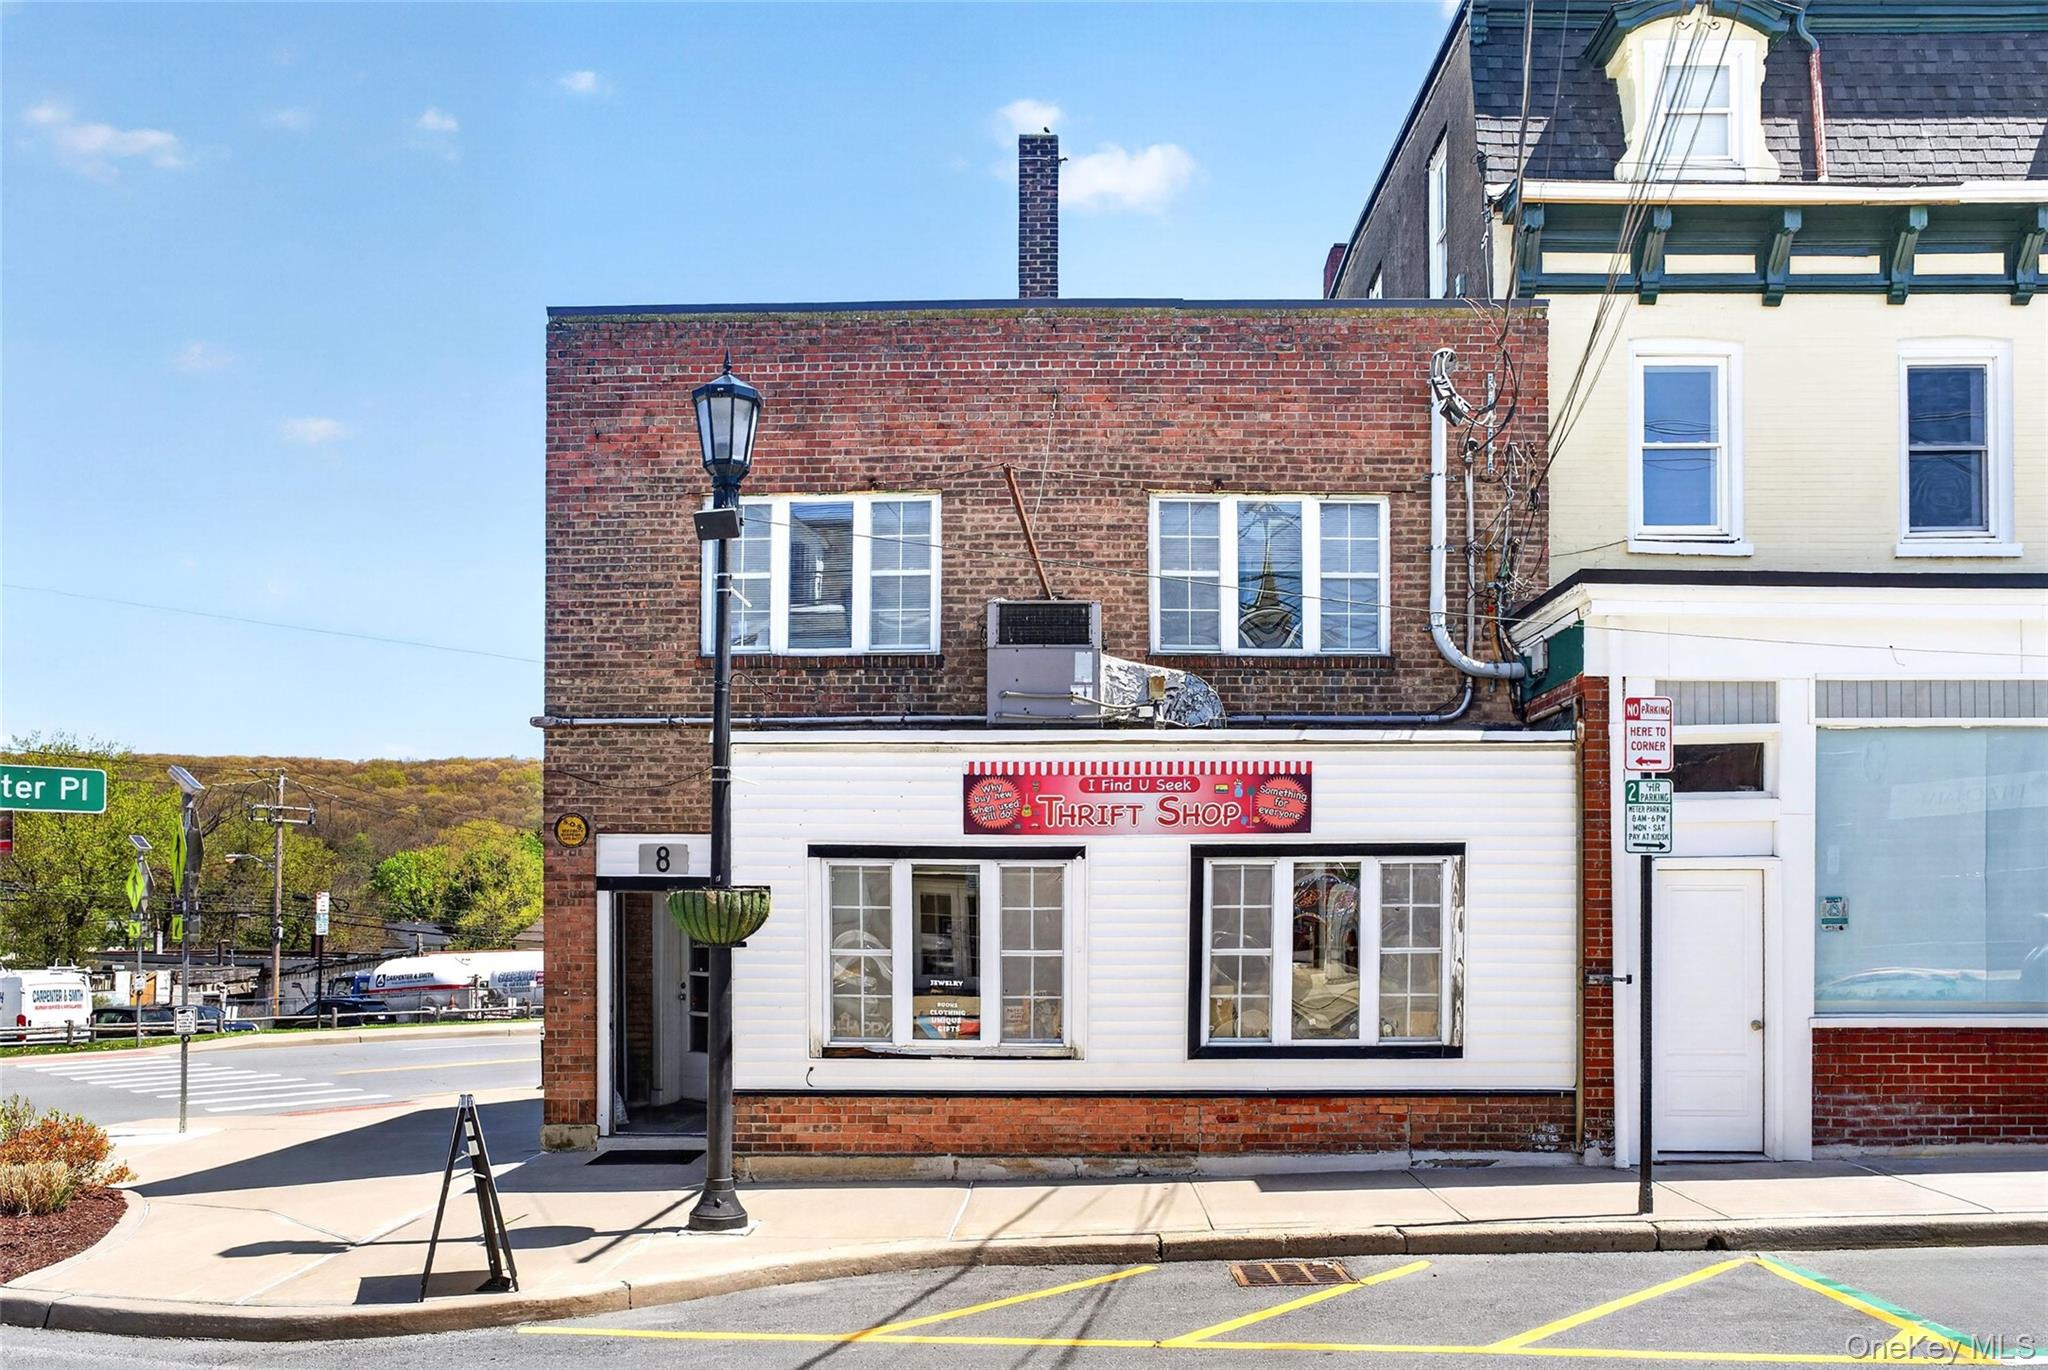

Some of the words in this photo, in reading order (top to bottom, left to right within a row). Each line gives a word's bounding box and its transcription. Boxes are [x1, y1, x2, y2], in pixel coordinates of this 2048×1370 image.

[1627, 703, 1639, 717] NO
[1641, 704, 1670, 716] PARKING
[1630, 726, 1653, 737] HERE
[1655, 726, 1666, 737] TO
[1631, 740, 1666, 751] CORNER
[60, 776, 88, 801] Pl
[981, 783, 1002, 793] Why
[1088, 779, 1095, 791] I
[1101, 778, 1132, 792] Find
[1139, 779, 1149, 791] U
[1155, 778, 1192, 791] Seek
[974, 794, 990, 803] buy
[994, 791, 1013, 799] new
[1260, 784, 1308, 803] Something
[1628, 783, 1637, 801] 2
[1640, 792, 1669, 802] PARKING
[971, 805, 995, 815] when
[998, 800, 1019, 810] used
[1274, 797, 1289, 807] for
[1036, 795, 1143, 827] THRIFT
[1156, 795, 1241, 827] SHOP
[1628, 805, 1645, 813] METER
[1646, 805, 1669, 813] PARKING
[981, 811, 996, 821] will
[1632, 823, 1647, 832] MON
[1652, 823, 1665, 832] SAT
[1628, 832, 1641, 840] PAY
[1641, 832, 1650, 840] AT
[1651, 832, 1669, 840] KIOSK
[656, 846, 670, 872] 8
[930, 979, 963, 987] JEWELRY
